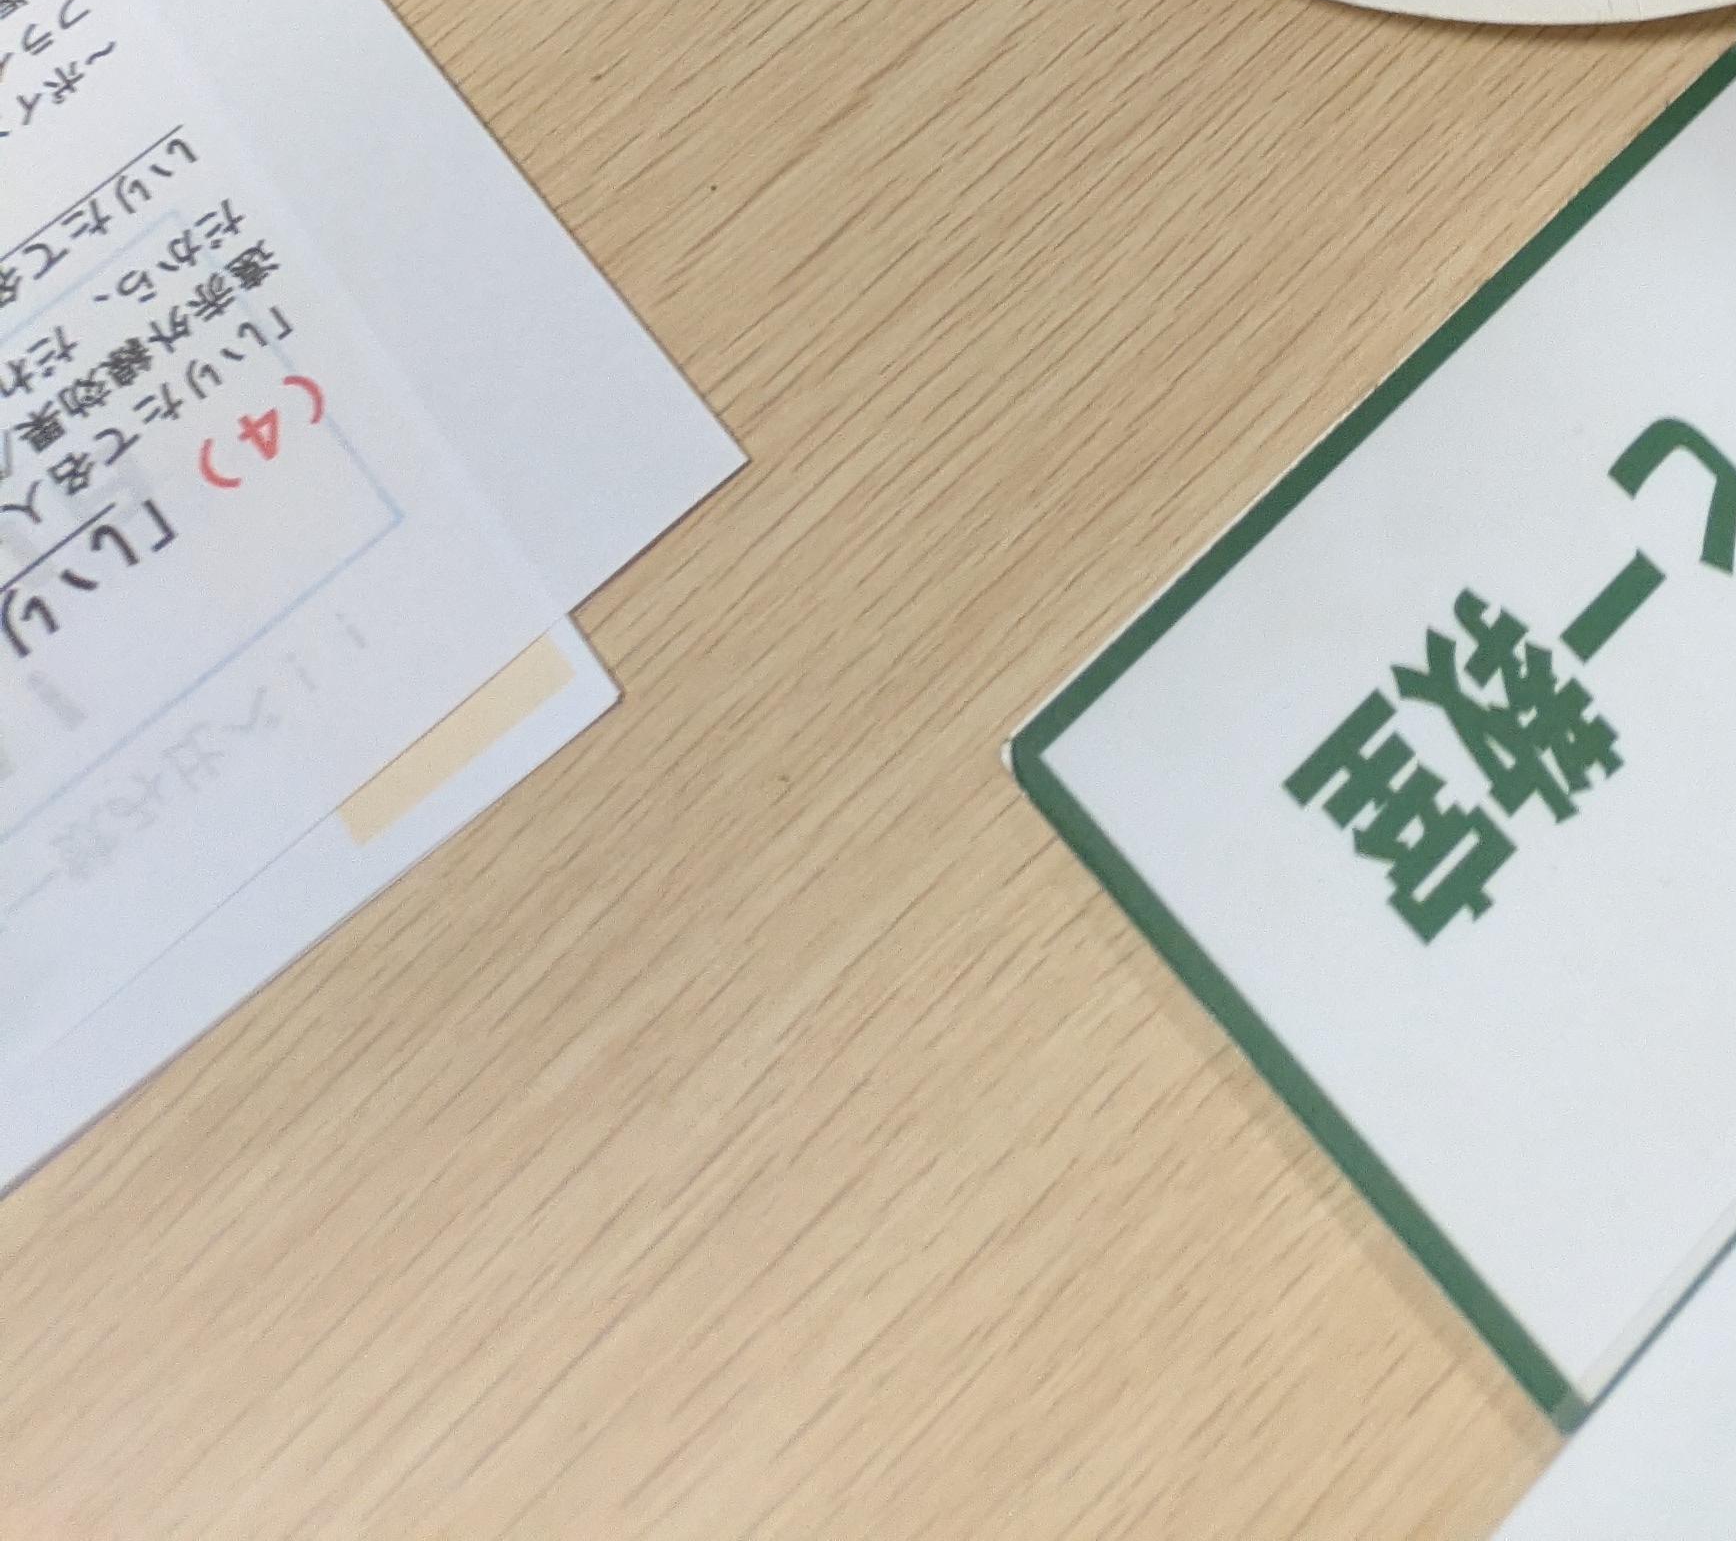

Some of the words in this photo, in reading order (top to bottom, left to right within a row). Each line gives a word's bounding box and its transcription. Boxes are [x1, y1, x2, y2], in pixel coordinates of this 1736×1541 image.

[14, 239, 281, 454] 遠赤外線効果
